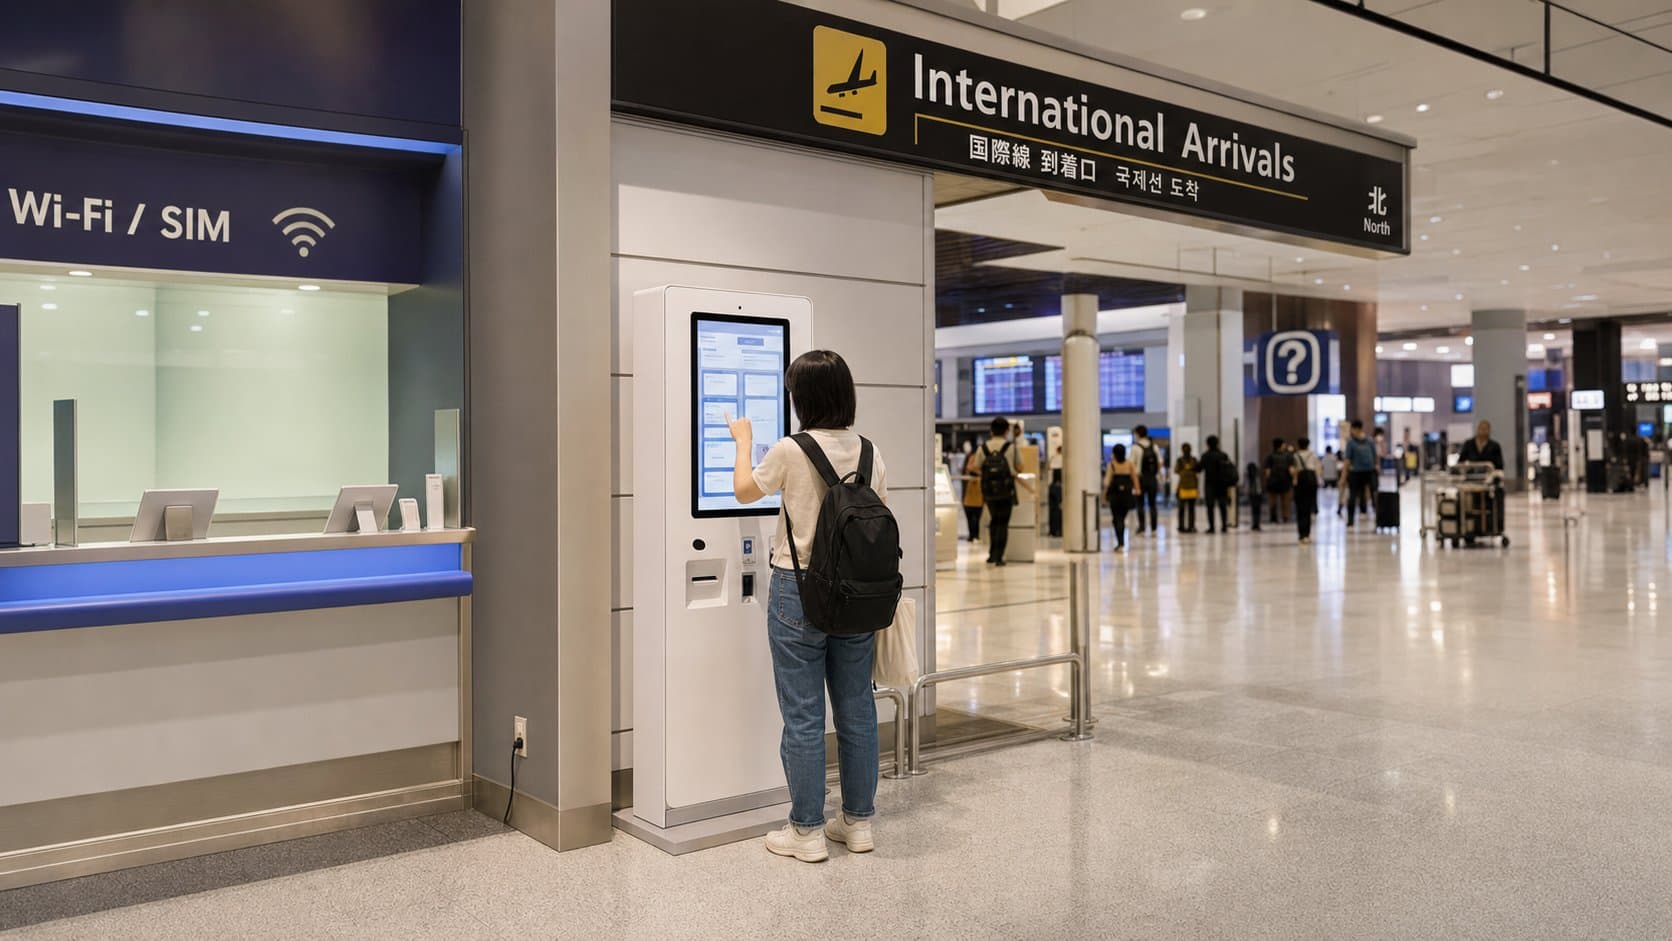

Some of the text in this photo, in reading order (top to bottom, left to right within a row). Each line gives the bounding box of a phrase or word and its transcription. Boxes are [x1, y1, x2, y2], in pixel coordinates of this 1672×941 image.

[914, 53, 1295, 183] International Arrivals
[969, 134, 1096, 183] 国際線 到着口
[1115, 165, 1200, 202] 국제선 도착
[1367, 185, 1388, 216] 北
[8, 188, 230, 243] Wi-Fi / SIM
[1363, 217, 1391, 236] North
